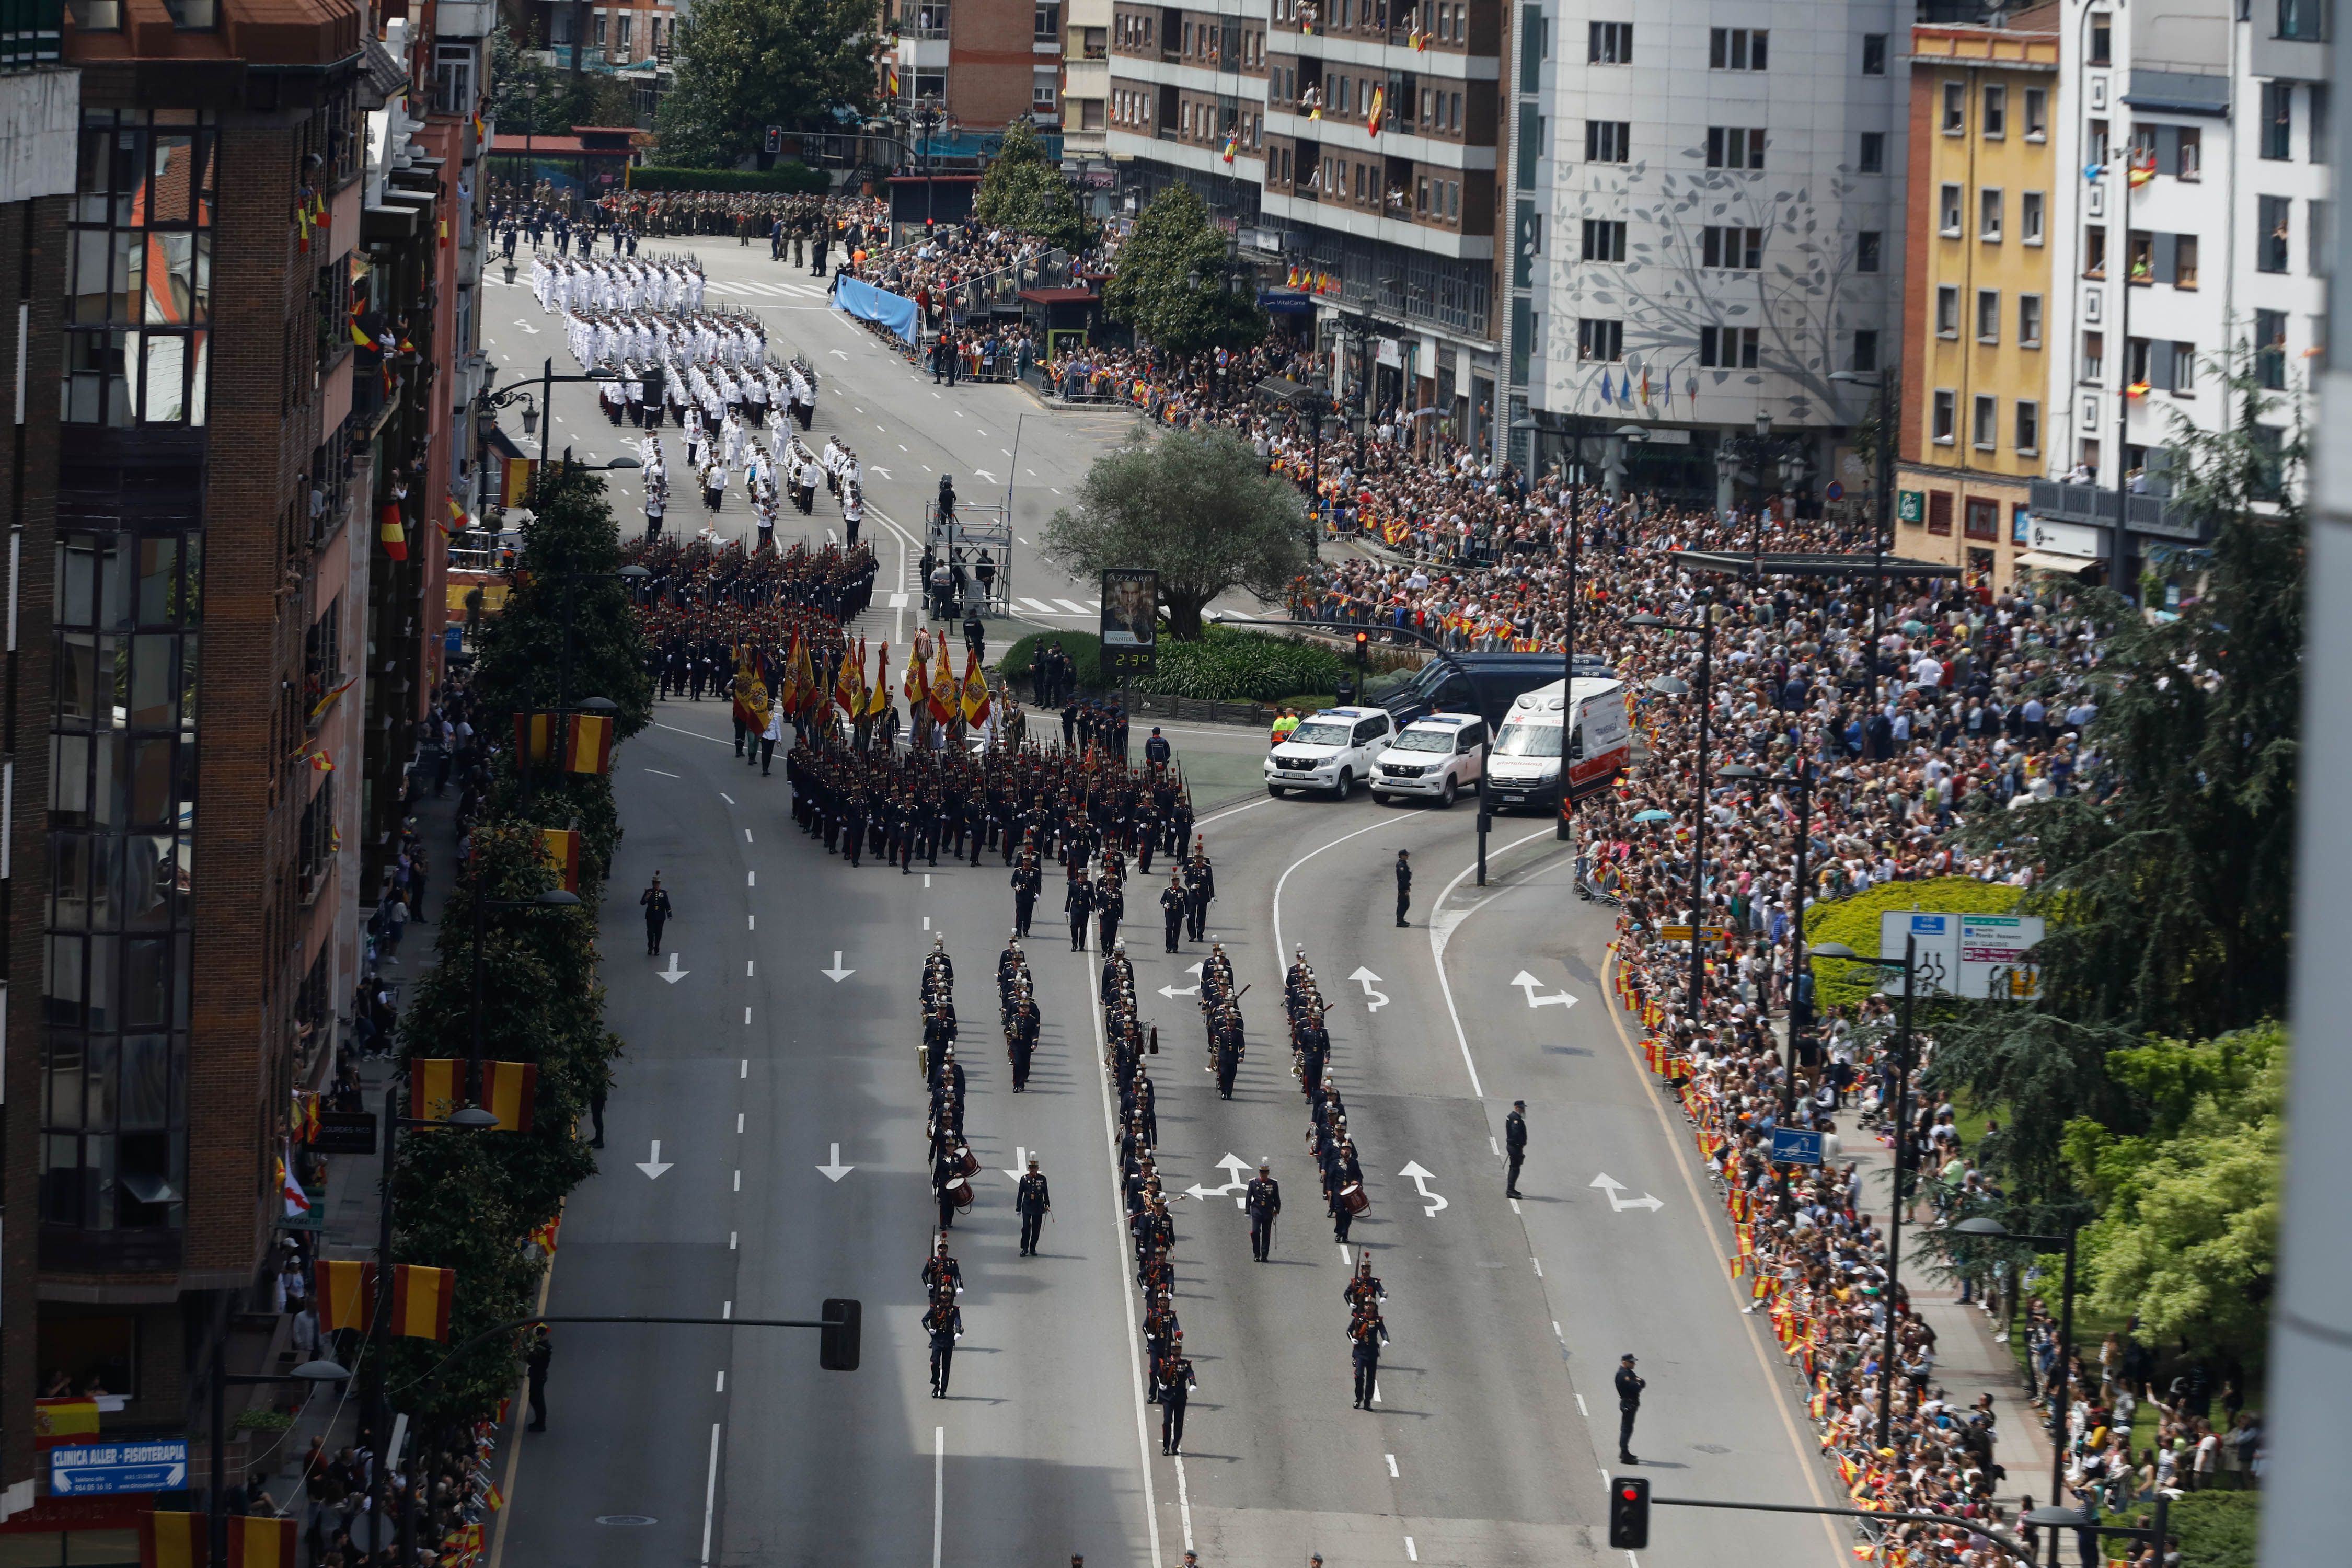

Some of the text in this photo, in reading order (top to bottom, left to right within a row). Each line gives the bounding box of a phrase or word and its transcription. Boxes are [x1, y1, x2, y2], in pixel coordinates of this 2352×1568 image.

[1108, 574, 1152, 582] AZZARO
[54, 1450, 88, 1467] CLINICA
[90, 1448, 117, 1464] ALLER
[123, 1445, 186, 1463] FISIOTERAPIA
